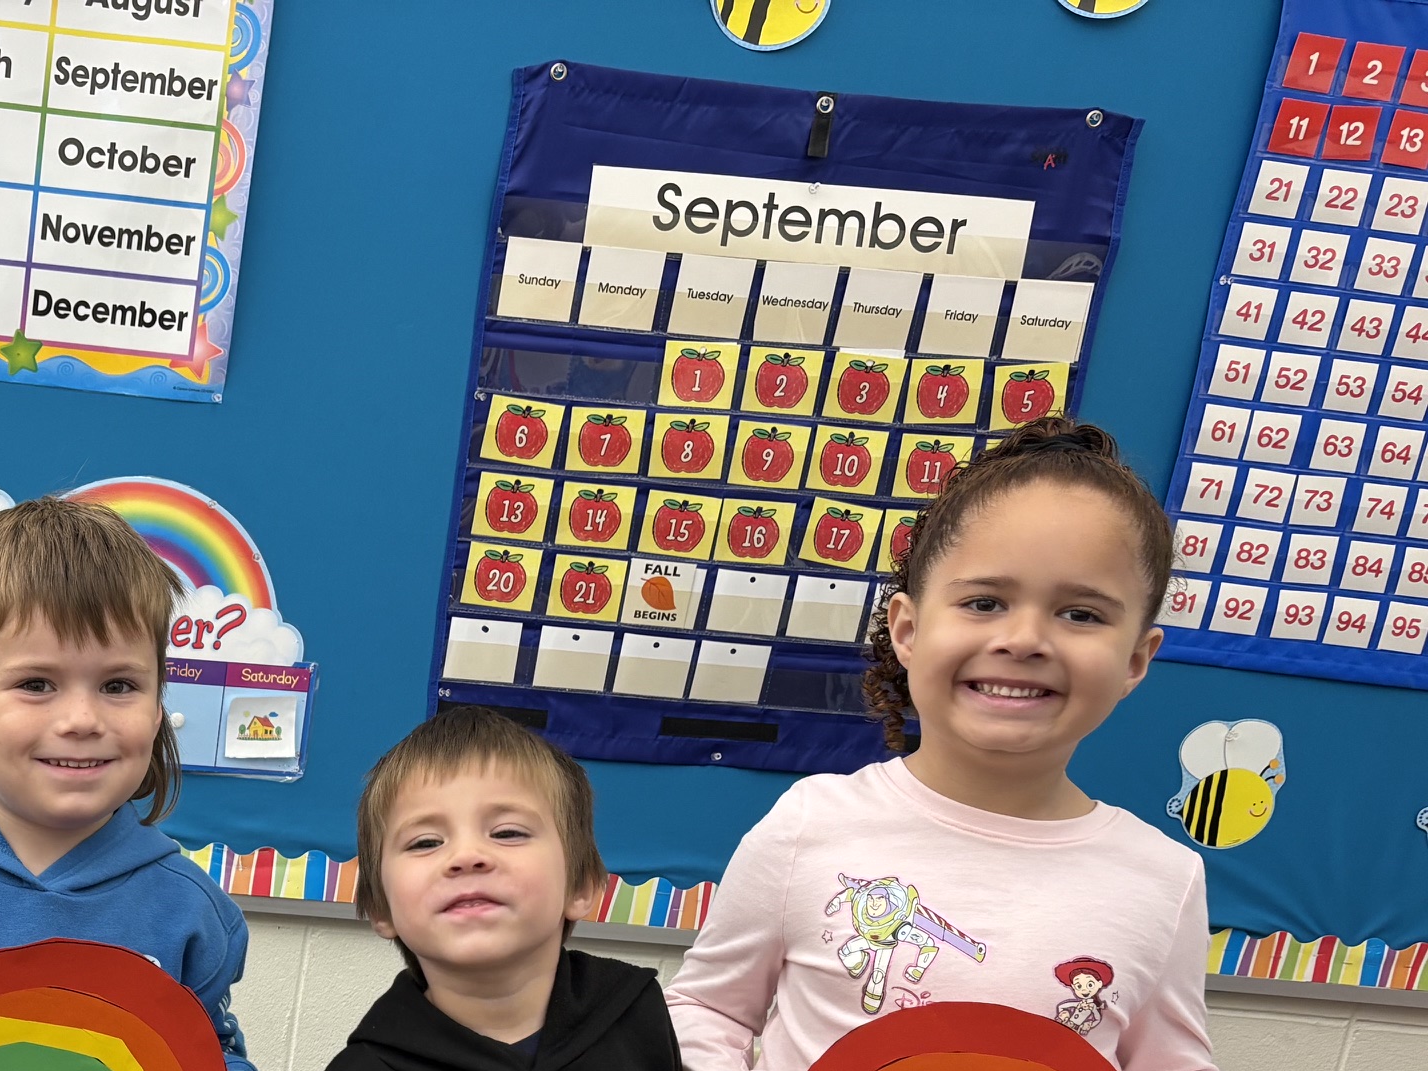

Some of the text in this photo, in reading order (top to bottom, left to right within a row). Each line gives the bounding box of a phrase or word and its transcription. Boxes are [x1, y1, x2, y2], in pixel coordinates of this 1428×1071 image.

[85, 0, 204, 21] ugust
[54, 56, 218, 101] September
[1308, 51, 1383, 85] 1 2
[1288, 116, 1425, 153] 11 12 13
[58, 137, 197, 179] October
[652, 182, 967, 255] September
[1265, 177, 1419, 220] 21 22 23
[40, 213, 196, 256] November
[1249, 239, 1402, 279] 31 32 33
[31, 289, 189, 332] December
[518, 273, 1072, 331] Sunday Monday Tuesday Wednesday Thursday Friday Saturday
[1236, 301, 1263, 324] 41
[1291, 308, 1326, 333] 42
[1350, 316, 1384, 340] 43
[691, 369, 1035, 412] 1 2 3 4 5
[1224, 359, 1424, 405] 51 52 53 54
[515, 425, 941, 483] 6 7 8 9 10 11
[1211, 419, 1412, 465] 61 62 63 64
[1199, 477, 1224, 500] 71
[1253, 483, 1284, 509] 72
[1304, 489, 1334, 513] 73
[1367, 497, 1396, 520] 74
[500, 499, 851, 550] 13 14 15 16 17
[644, 563, 681, 577] FALL
[1181, 535, 1209, 557] 81
[1235, 541, 1270, 566] 82
[1293, 547, 1328, 571] 83
[1351, 555, 1384, 577] 84
[486, 569, 596, 604] 20 21
[171, 603, 247, 650] er?
[633, 610, 677, 622] BEGINS
[1171, 591, 1421, 640] 91 92 93 94 95
[241, 668, 300, 688] Saturday
